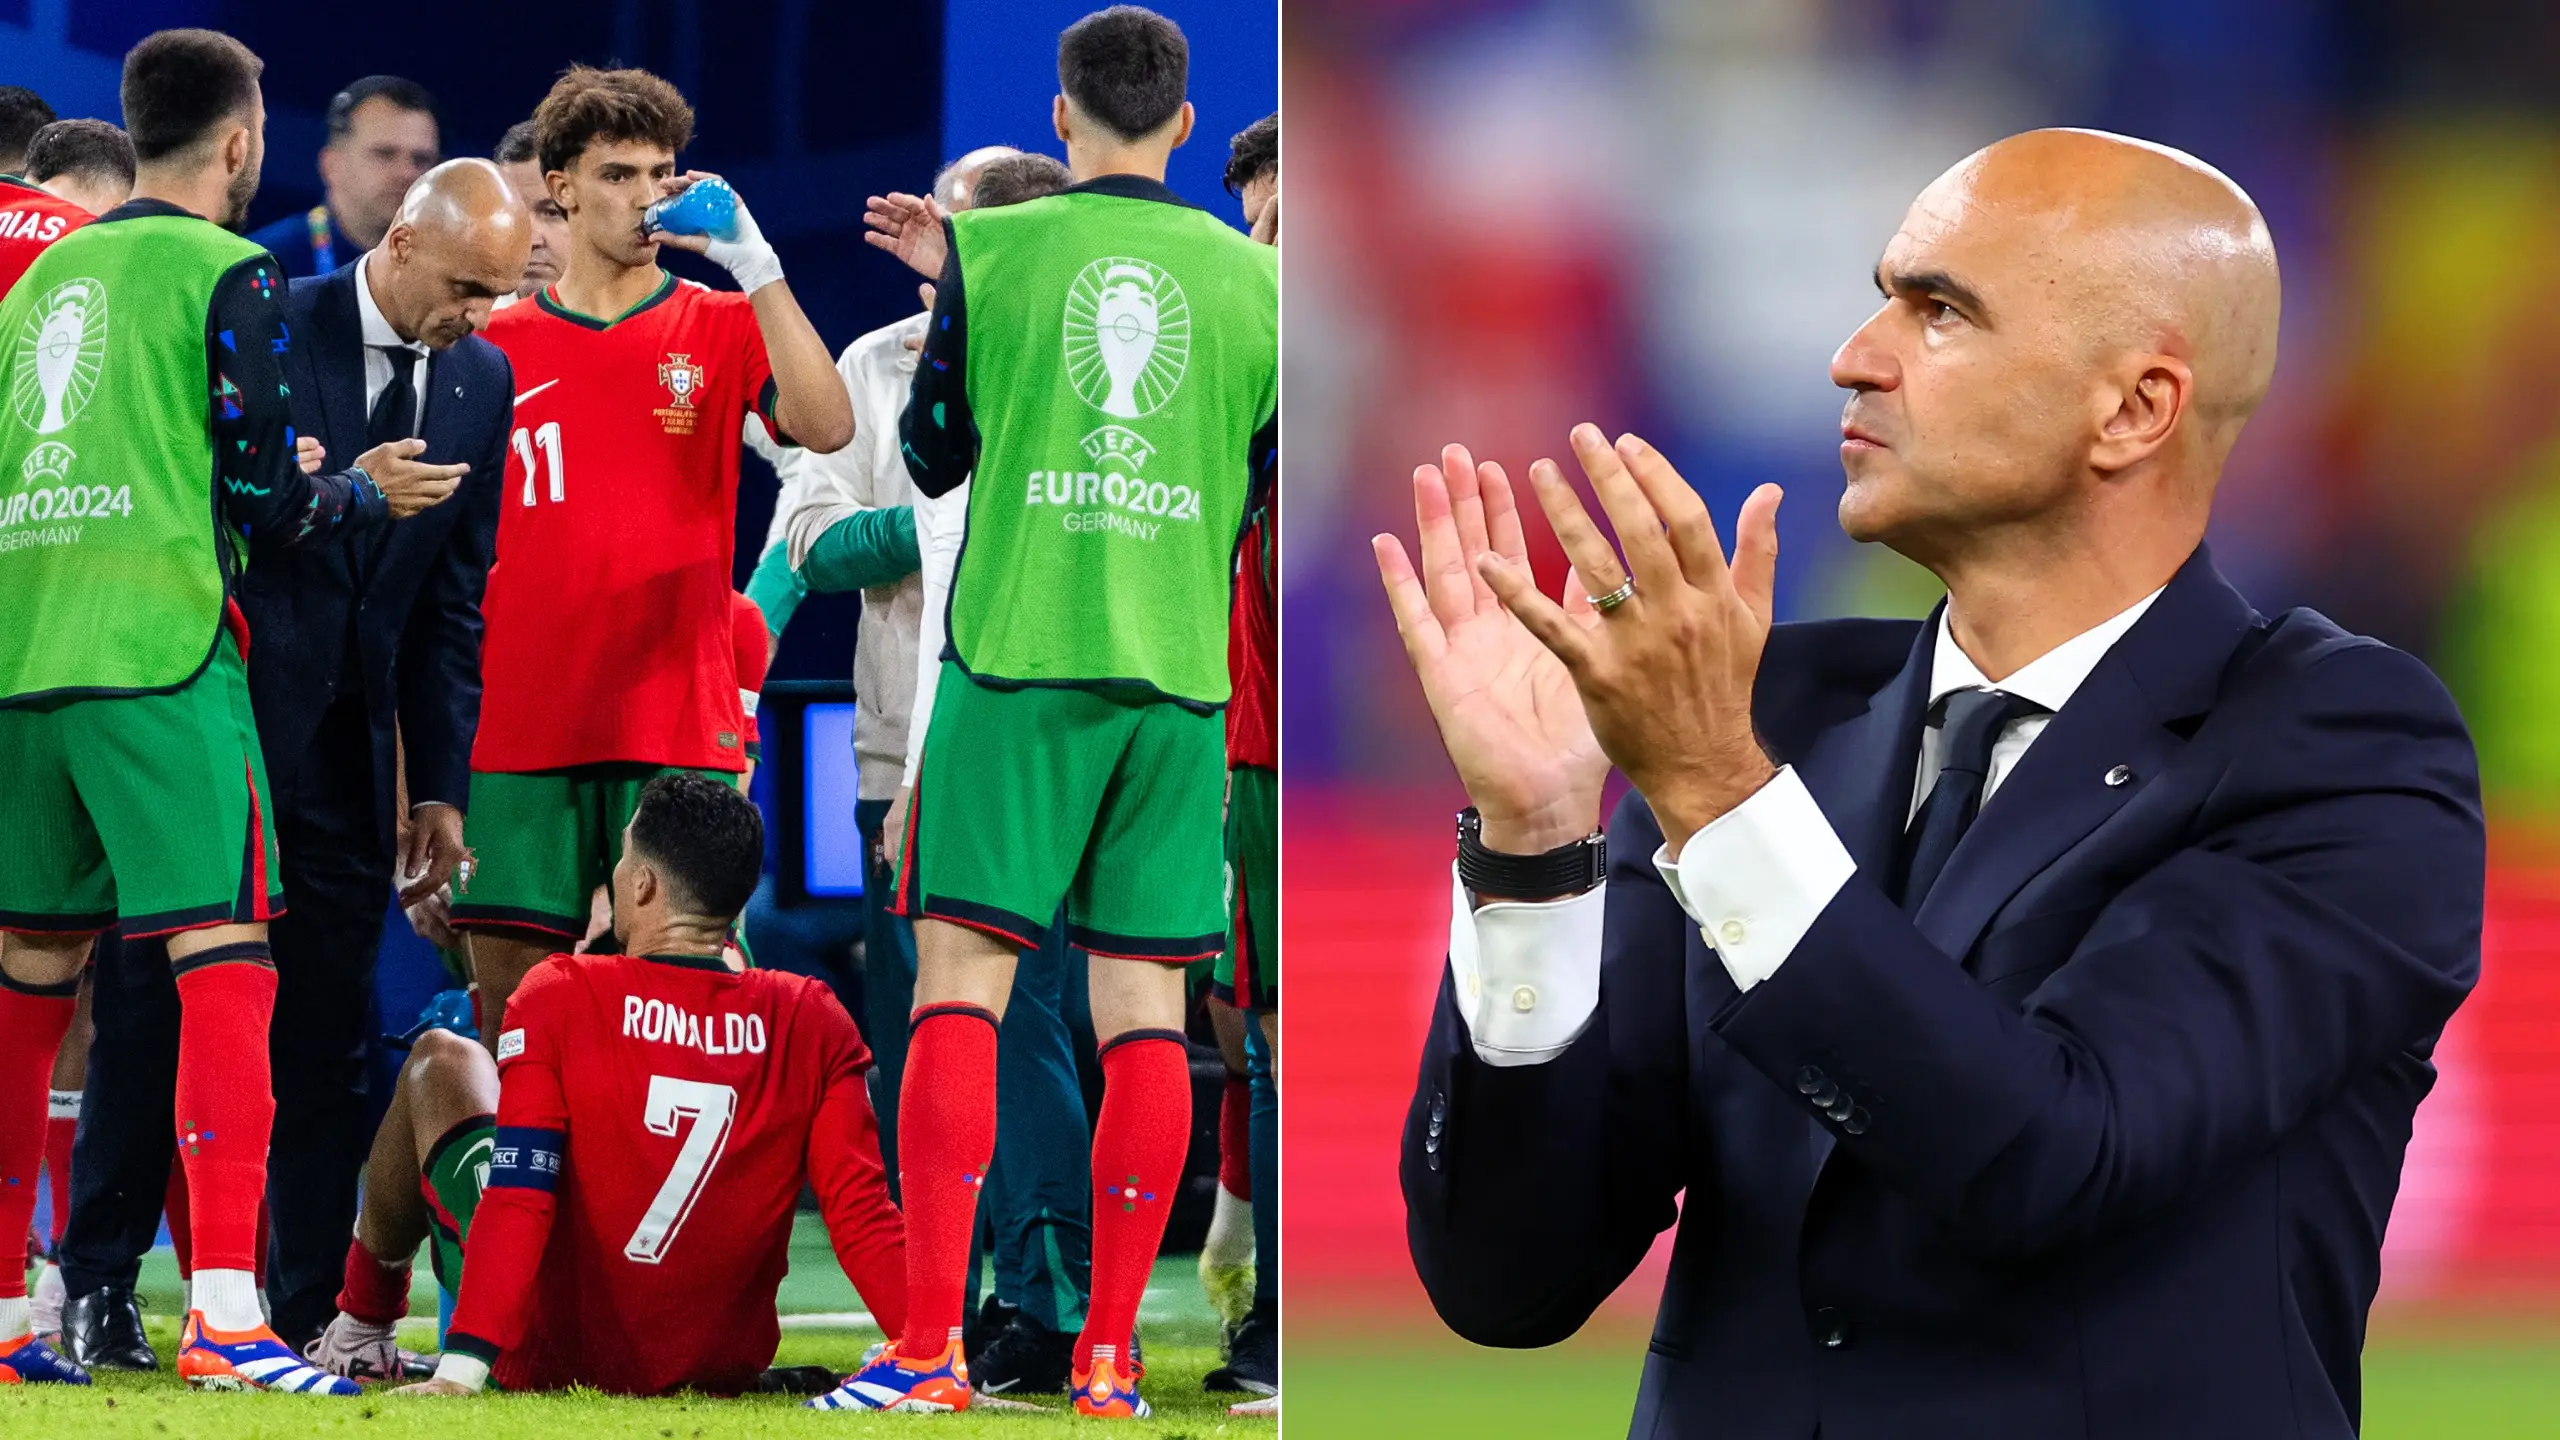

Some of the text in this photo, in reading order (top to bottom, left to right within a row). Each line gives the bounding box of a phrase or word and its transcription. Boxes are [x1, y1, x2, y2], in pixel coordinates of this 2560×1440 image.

[23, 447, 70, 480] UEFA
[512, 421, 565, 507] 11
[1084, 431, 1148, 468] UEFA
[0, 484, 133, 528] URO2024
[1026, 470, 1201, 523] EURO2024
[0, 524, 84, 552] GERMANY
[1063, 511, 1162, 541] GERMANY
[622, 994, 767, 1056] RONALDO
[623, 1074, 738, 1265] 7
